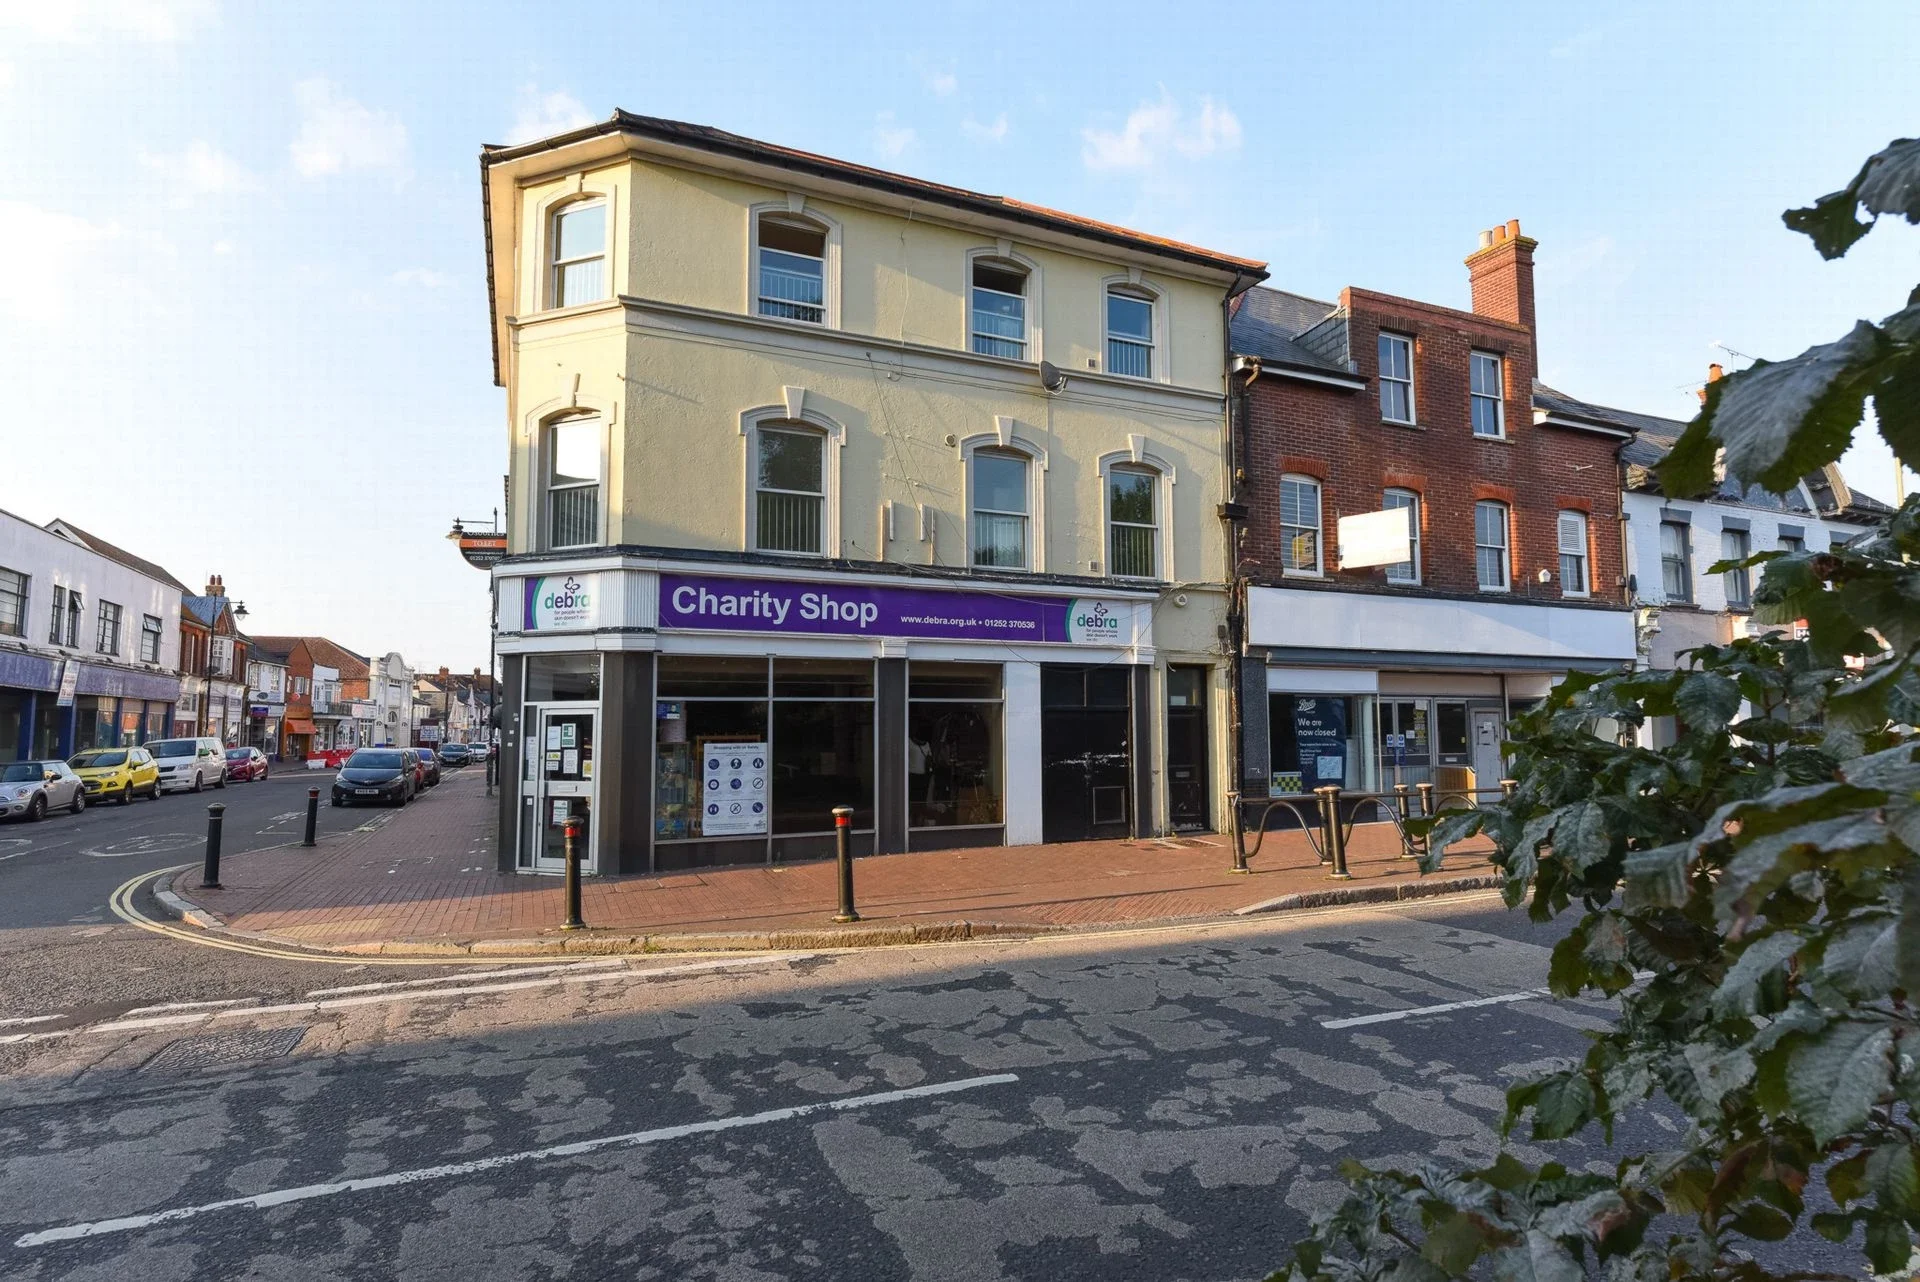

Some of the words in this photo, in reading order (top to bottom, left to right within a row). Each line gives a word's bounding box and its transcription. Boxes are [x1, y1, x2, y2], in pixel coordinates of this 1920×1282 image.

[544, 591, 591, 609] debra
[672, 586, 791, 625] Charity
[799, 593, 878, 628] Shop
[900, 615, 977, 627] www.debra.org.uk
[984, 619, 1008, 628] 01252
[1077, 614, 1118, 628] debra
[1298, 718, 1310, 726] We
[1314, 728, 1336, 736] closed
